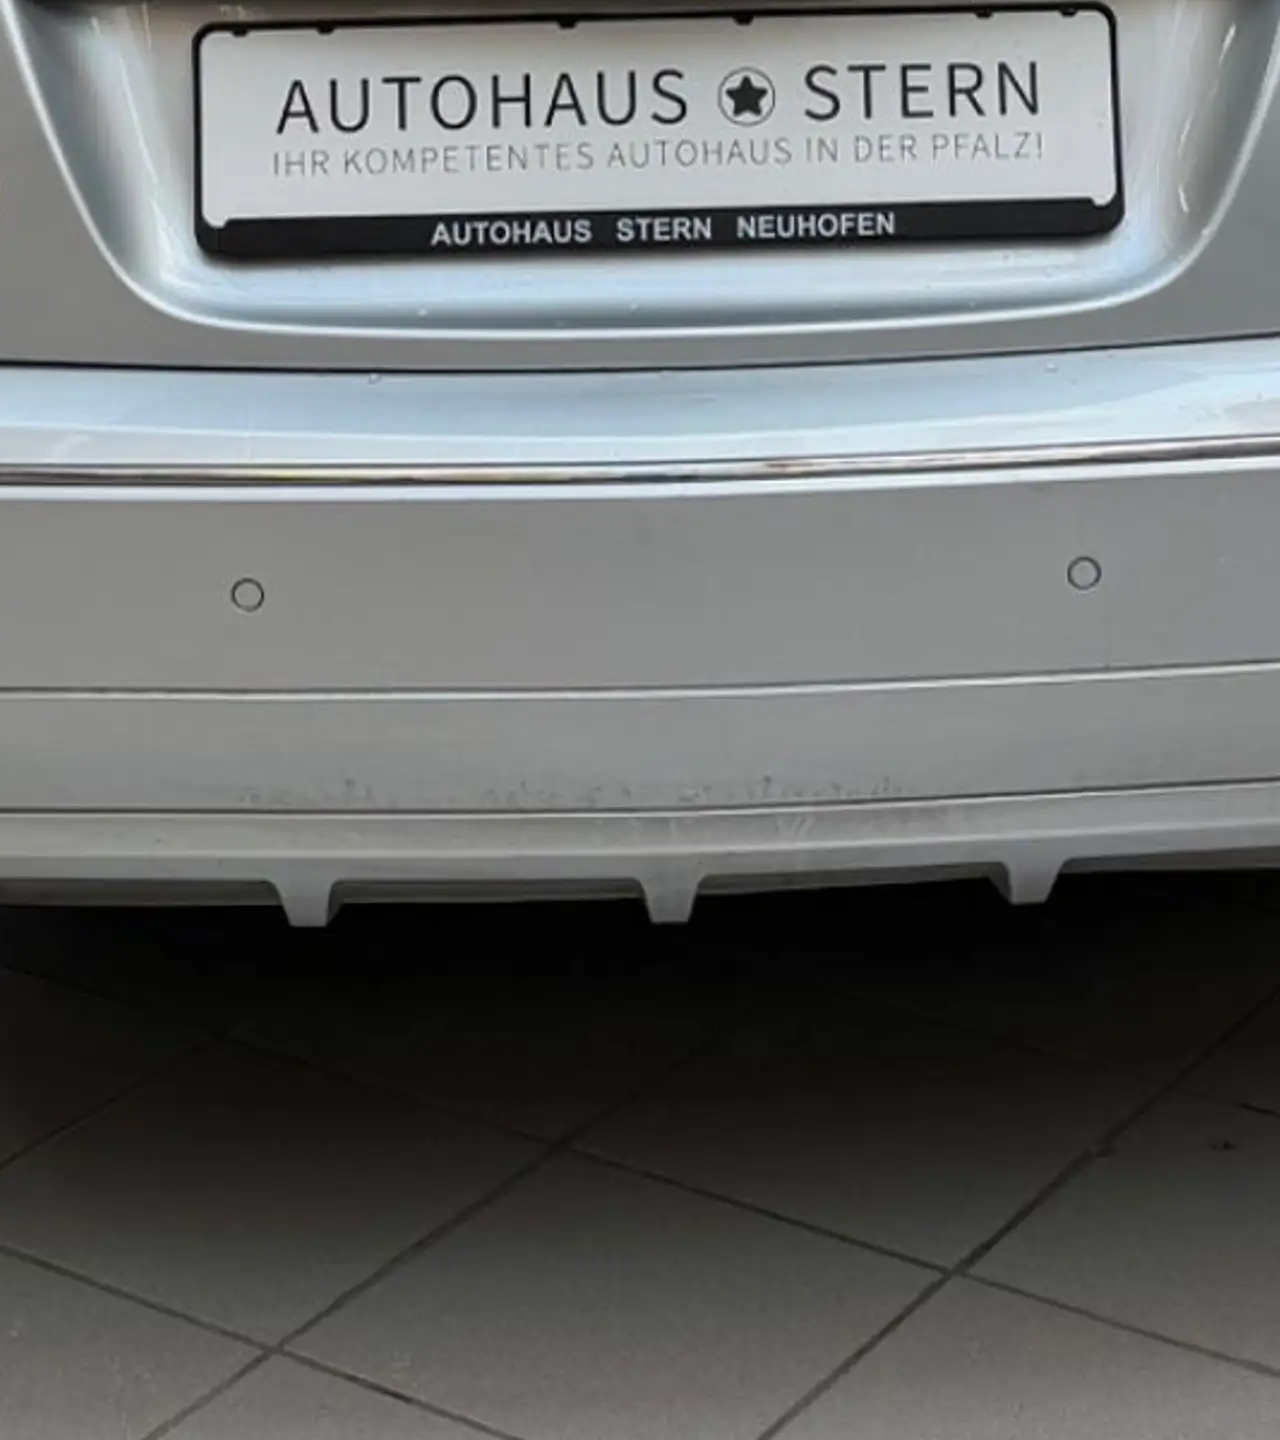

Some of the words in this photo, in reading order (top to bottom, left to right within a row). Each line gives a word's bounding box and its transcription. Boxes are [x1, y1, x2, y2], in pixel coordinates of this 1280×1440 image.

[276, 68, 688, 135] AUTOHAUS
[804, 61, 1040, 121] STERN
[273, 150, 330, 177] IHR
[343, 141, 595, 176] KOMPETENTES
[607, 136, 793, 169] AUTOHAUS
[806, 135, 839, 163] IN
[853, 133, 919, 162] DER
[932, 131, 1044, 161] PFALZ!
[430, 219, 593, 247] AUTOHAUS
[616, 216, 713, 242] STERN
[736, 212, 896, 240] NEUHOFEN
